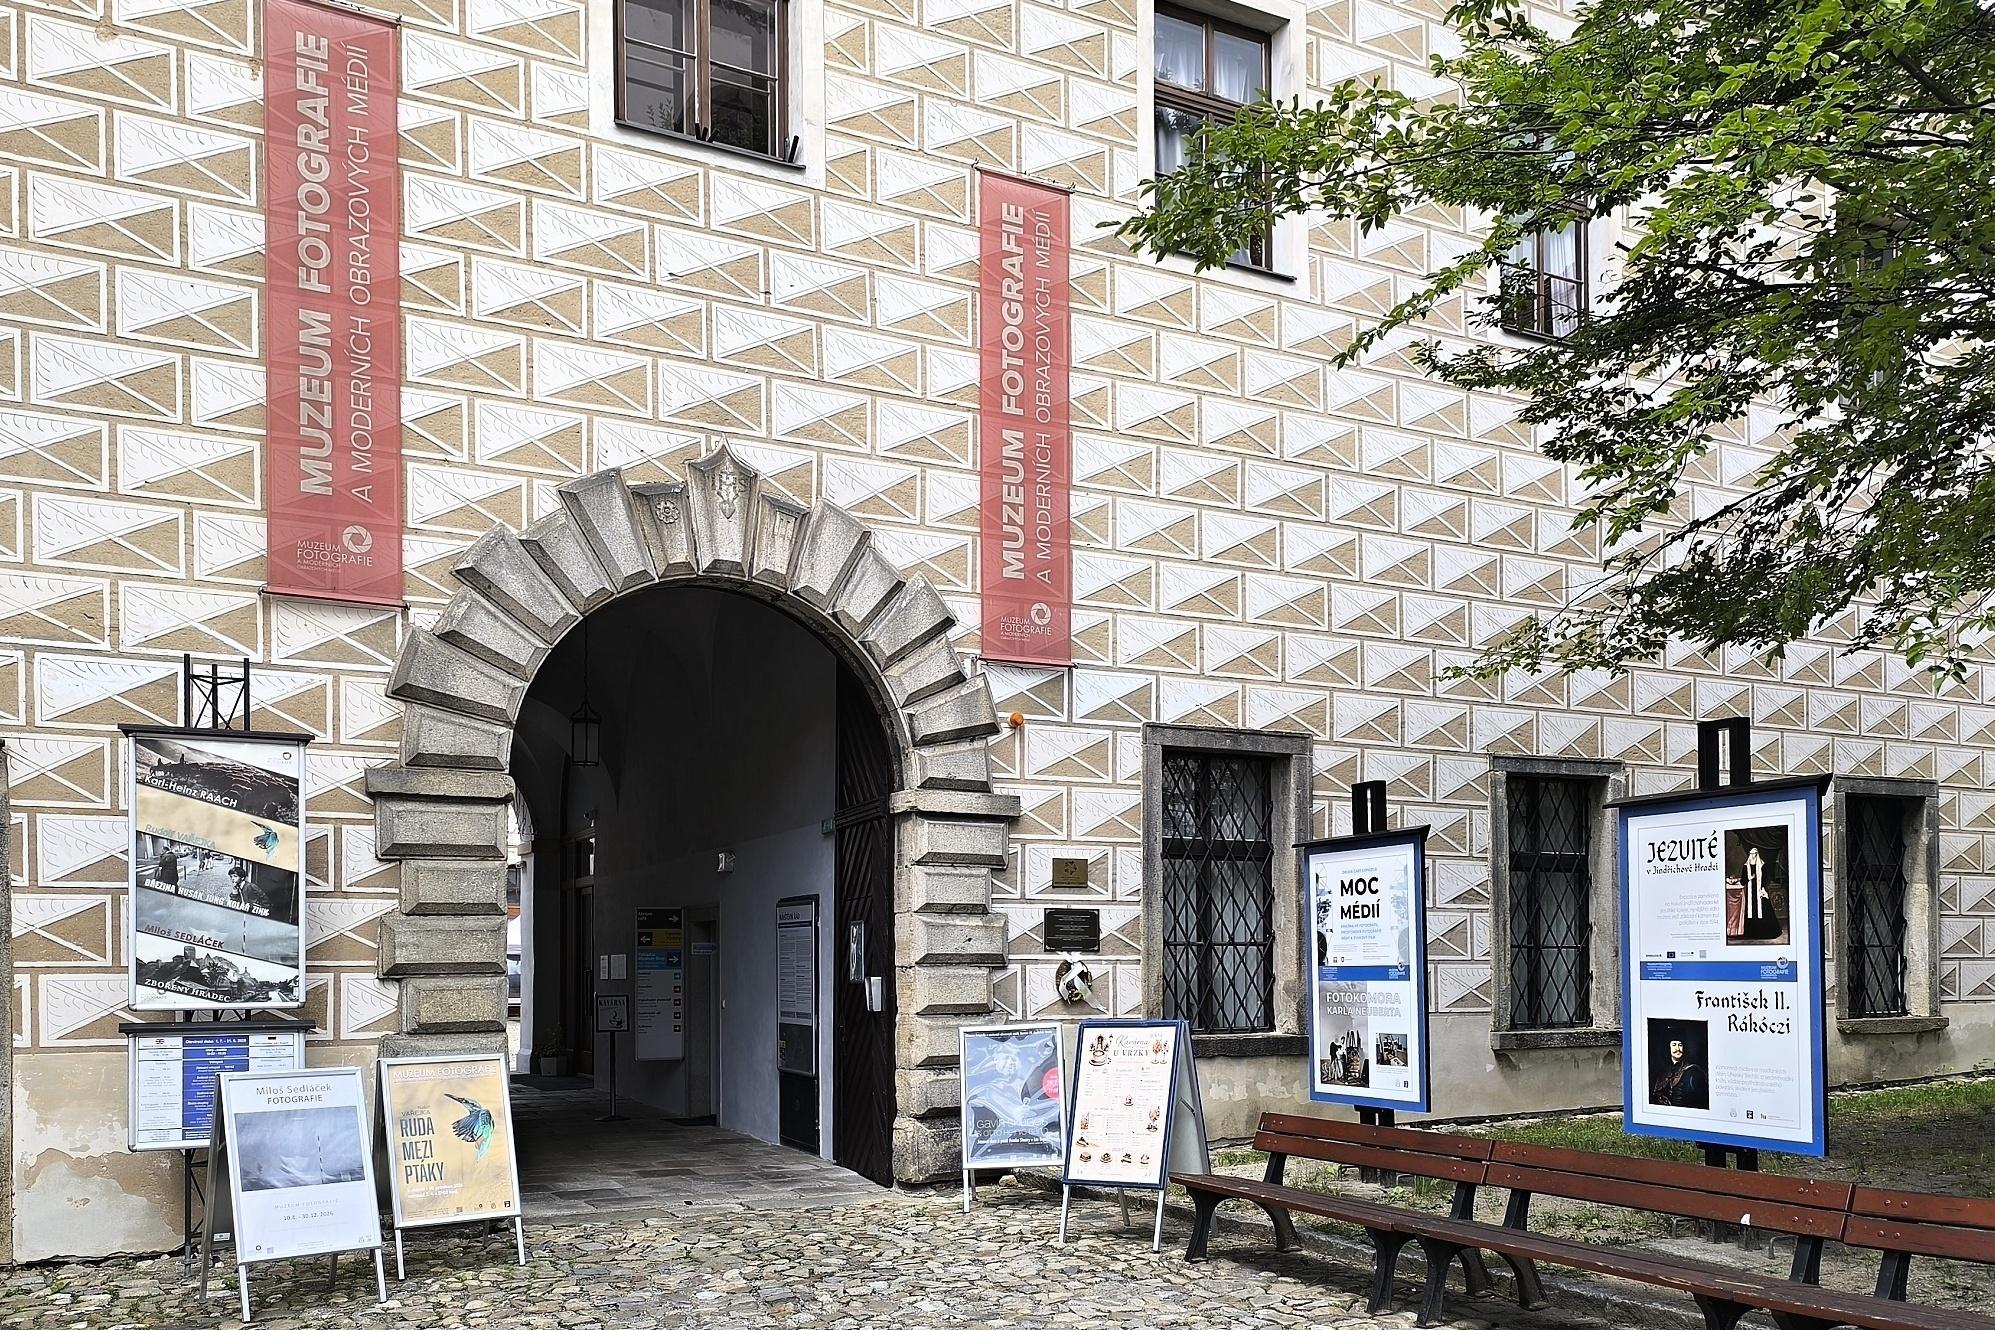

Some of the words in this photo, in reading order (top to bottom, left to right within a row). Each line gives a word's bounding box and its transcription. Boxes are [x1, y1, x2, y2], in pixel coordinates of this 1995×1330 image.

[341, 41, 369, 116] MÉDIÍ
[296, 31, 331, 293] FOTOGRAFIE
[342, 126, 371, 305] OBRAZOVÝCH
[1031, 209, 1050, 268] MÉDIÍ
[1001, 202, 1024, 416] FOTOGRAFIE
[1032, 277, 1050, 424] OBRAZOVÝCH
[299, 308, 333, 496] MUZEUM
[344, 315, 372, 472] MODERNÍCH
[351, 485, 373, 503] A
[1002, 429, 1024, 580] MUZEUM
[1032, 432, 1051, 560] MODERNÍCH
[297, 540, 341, 552] MUZEUM
[297, 549, 373, 566] FOTOGRAFIE
[1037, 569, 1051, 584] A
[1000, 616, 1031, 625] MUZEUM
[1000, 623, 1052, 636] FOTOGRAFIE
[144, 773, 197, 797] Karl-Heinz
[200, 791, 238, 808] RAACH
[145, 824, 176, 839] Rudolf
[1647, 830, 1719, 864] JEZUITÉ
[1652, 862, 1693, 875] Jindřichově
[1694, 862, 1719, 873] Hradci
[1340, 876, 1379, 897] MOC
[206, 894, 224, 906] JUNG
[1340, 898, 1381, 920] MÉDIÍ
[145, 924, 171, 938] Miloš
[174, 931, 224, 949] SEDLÁČEK
[145, 978, 190, 995] ZBOŘENÝ
[192, 988, 231, 1003] HRADEC
[1326, 992, 1401, 1004] FOTOKOMORA
[1695, 989, 1769, 1010] František
[1774, 991, 1790, 1010] II.
[1327, 1006, 1353, 1016] KARLA
[1727, 1012, 1791, 1035] Rákóczi
[1113, 1049, 1119, 1057] U
[393, 1069, 435, 1079] MUZEUM
[438, 1065, 497, 1076] FOTOGRAFIE
[287, 1083, 332, 1094] Sedláček
[267, 1095, 323, 1105] FOTOGRAFIE
[400, 1116, 435, 1138] RUDA
[402, 1139, 434, 1161] MEZI
[404, 1159, 444, 1185] PTÁKY
